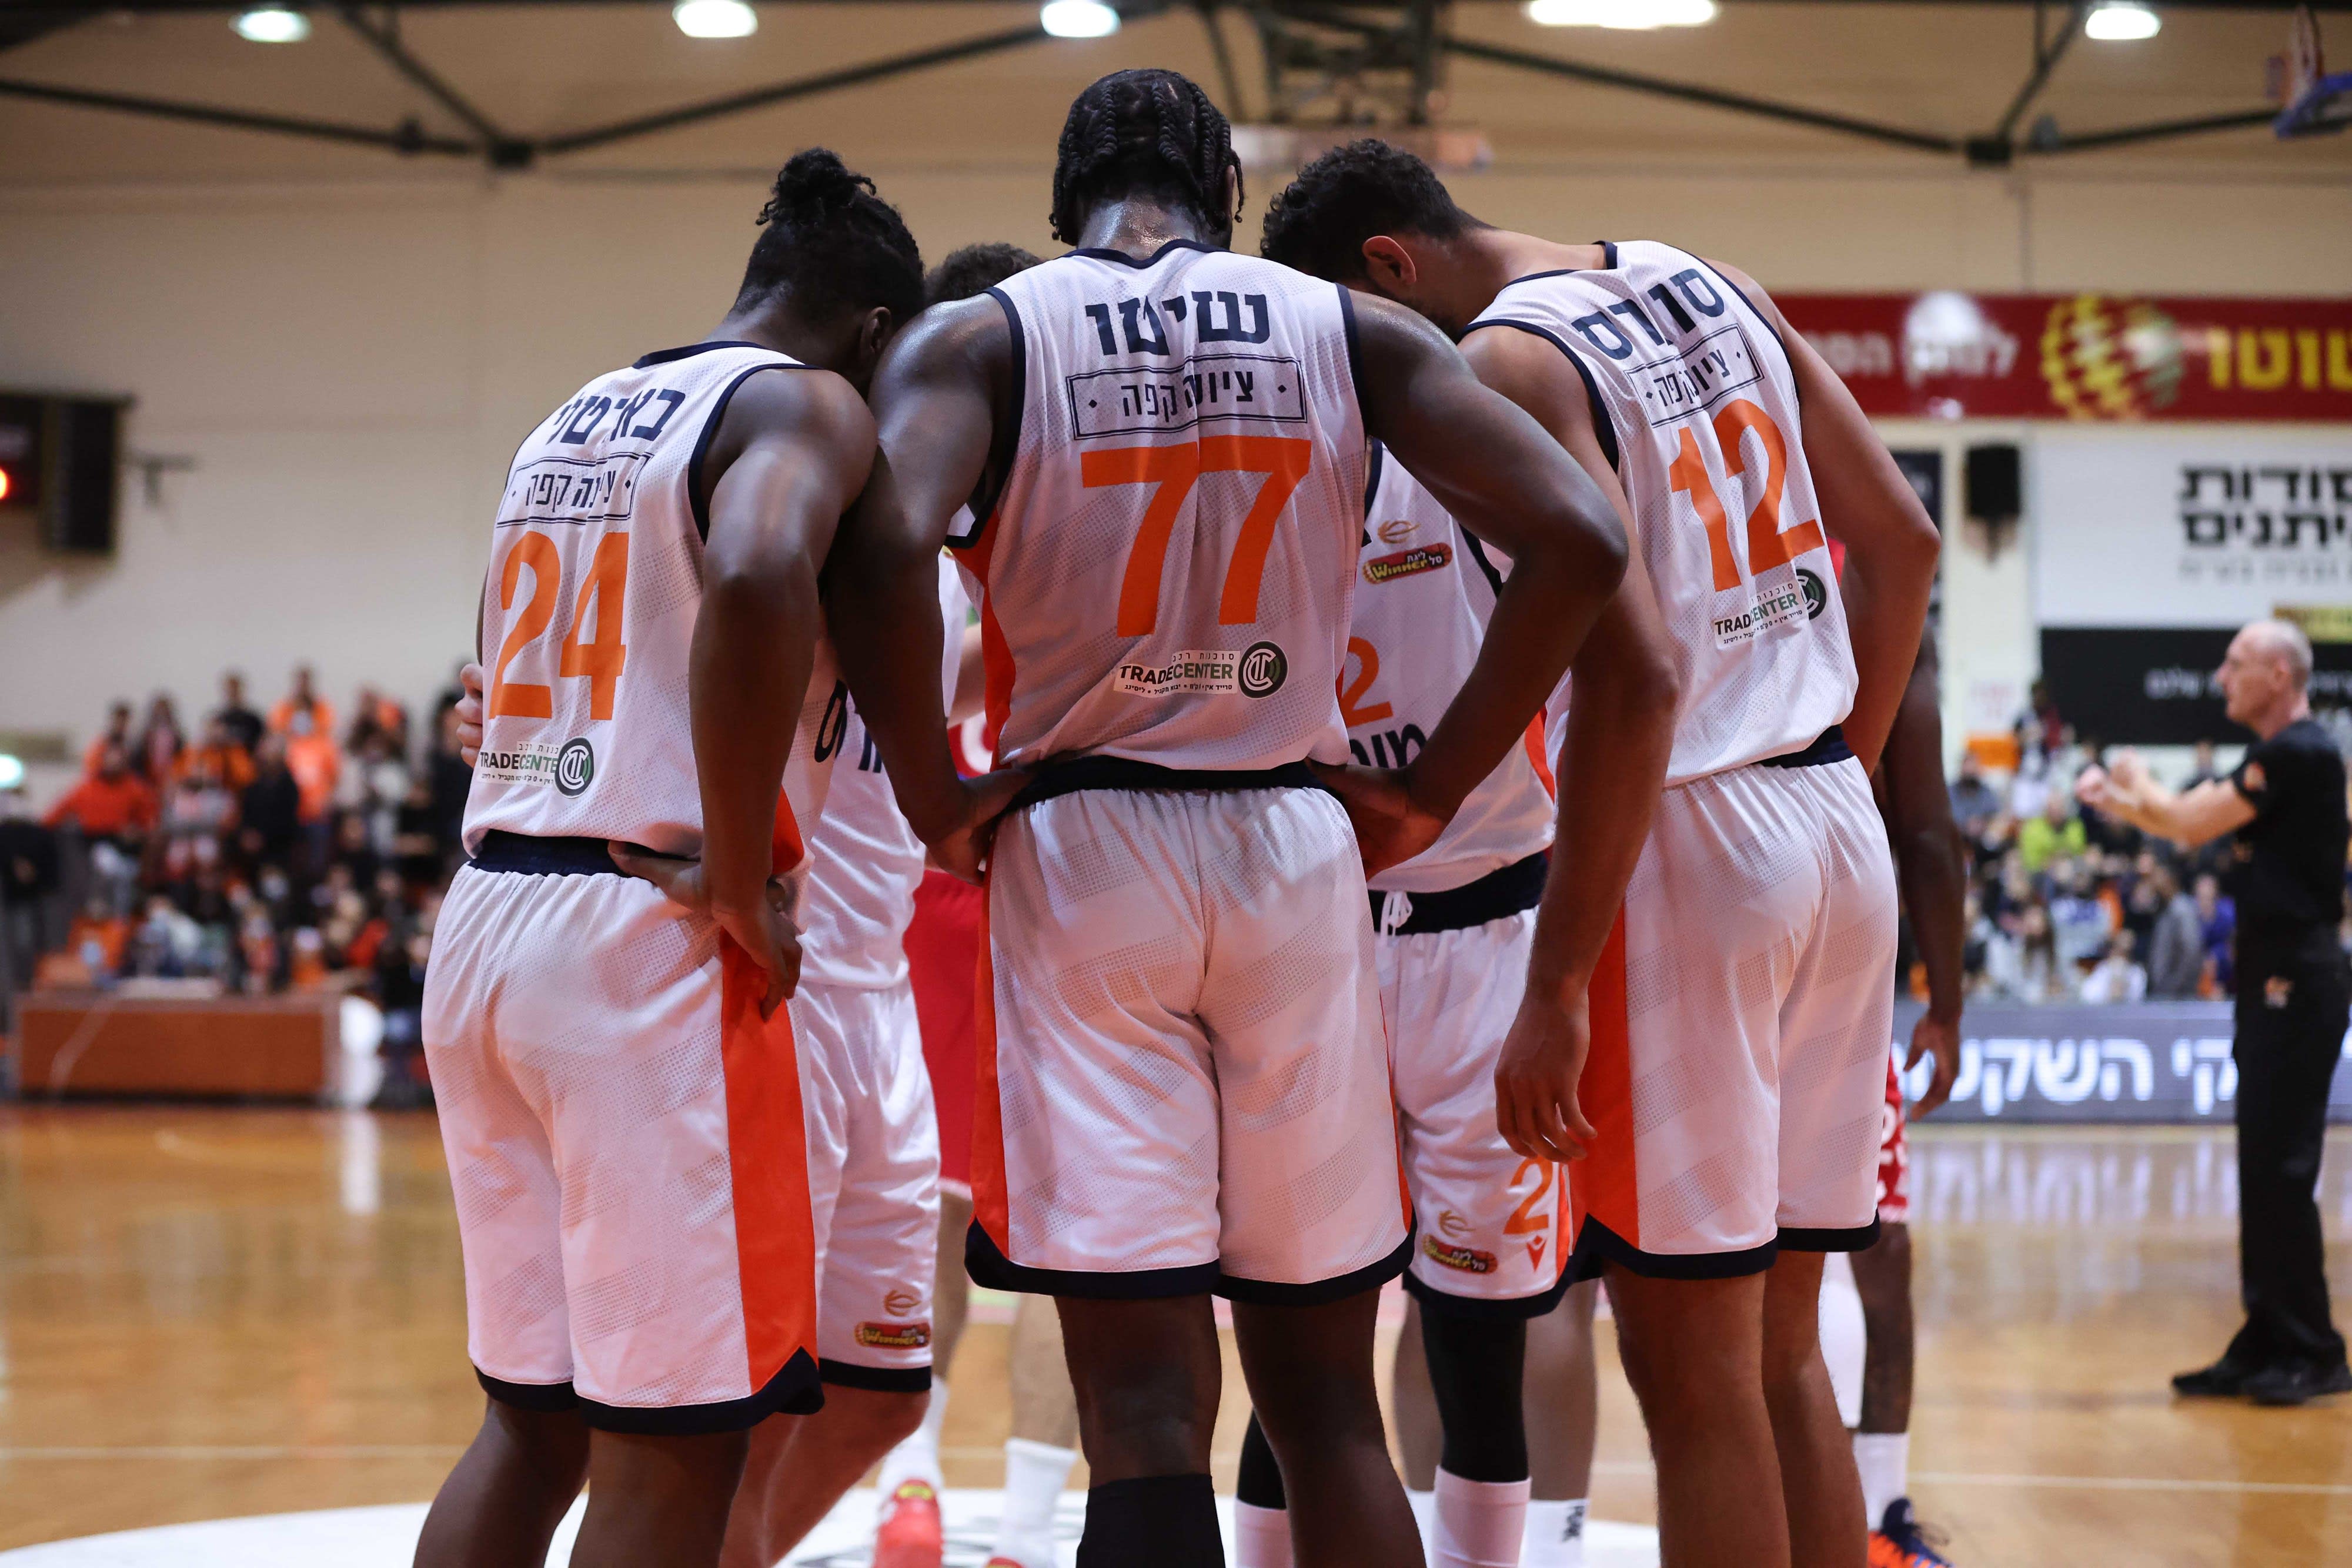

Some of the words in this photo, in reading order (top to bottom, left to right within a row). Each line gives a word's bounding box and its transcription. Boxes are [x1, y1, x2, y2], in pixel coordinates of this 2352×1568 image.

[1085, 290, 1270, 356] שיטו
[1121, 383, 1178, 423] קפה
[525, 474, 572, 513] קפה
[1669, 399, 1825, 593] 12
[1081, 435, 1312, 637] 77
[1371, 559, 1428, 579] Winner
[1429, 555, 1442, 565] סל
[489, 530, 630, 721] 24
[1120, 662, 1234, 685] TRADECENTER
